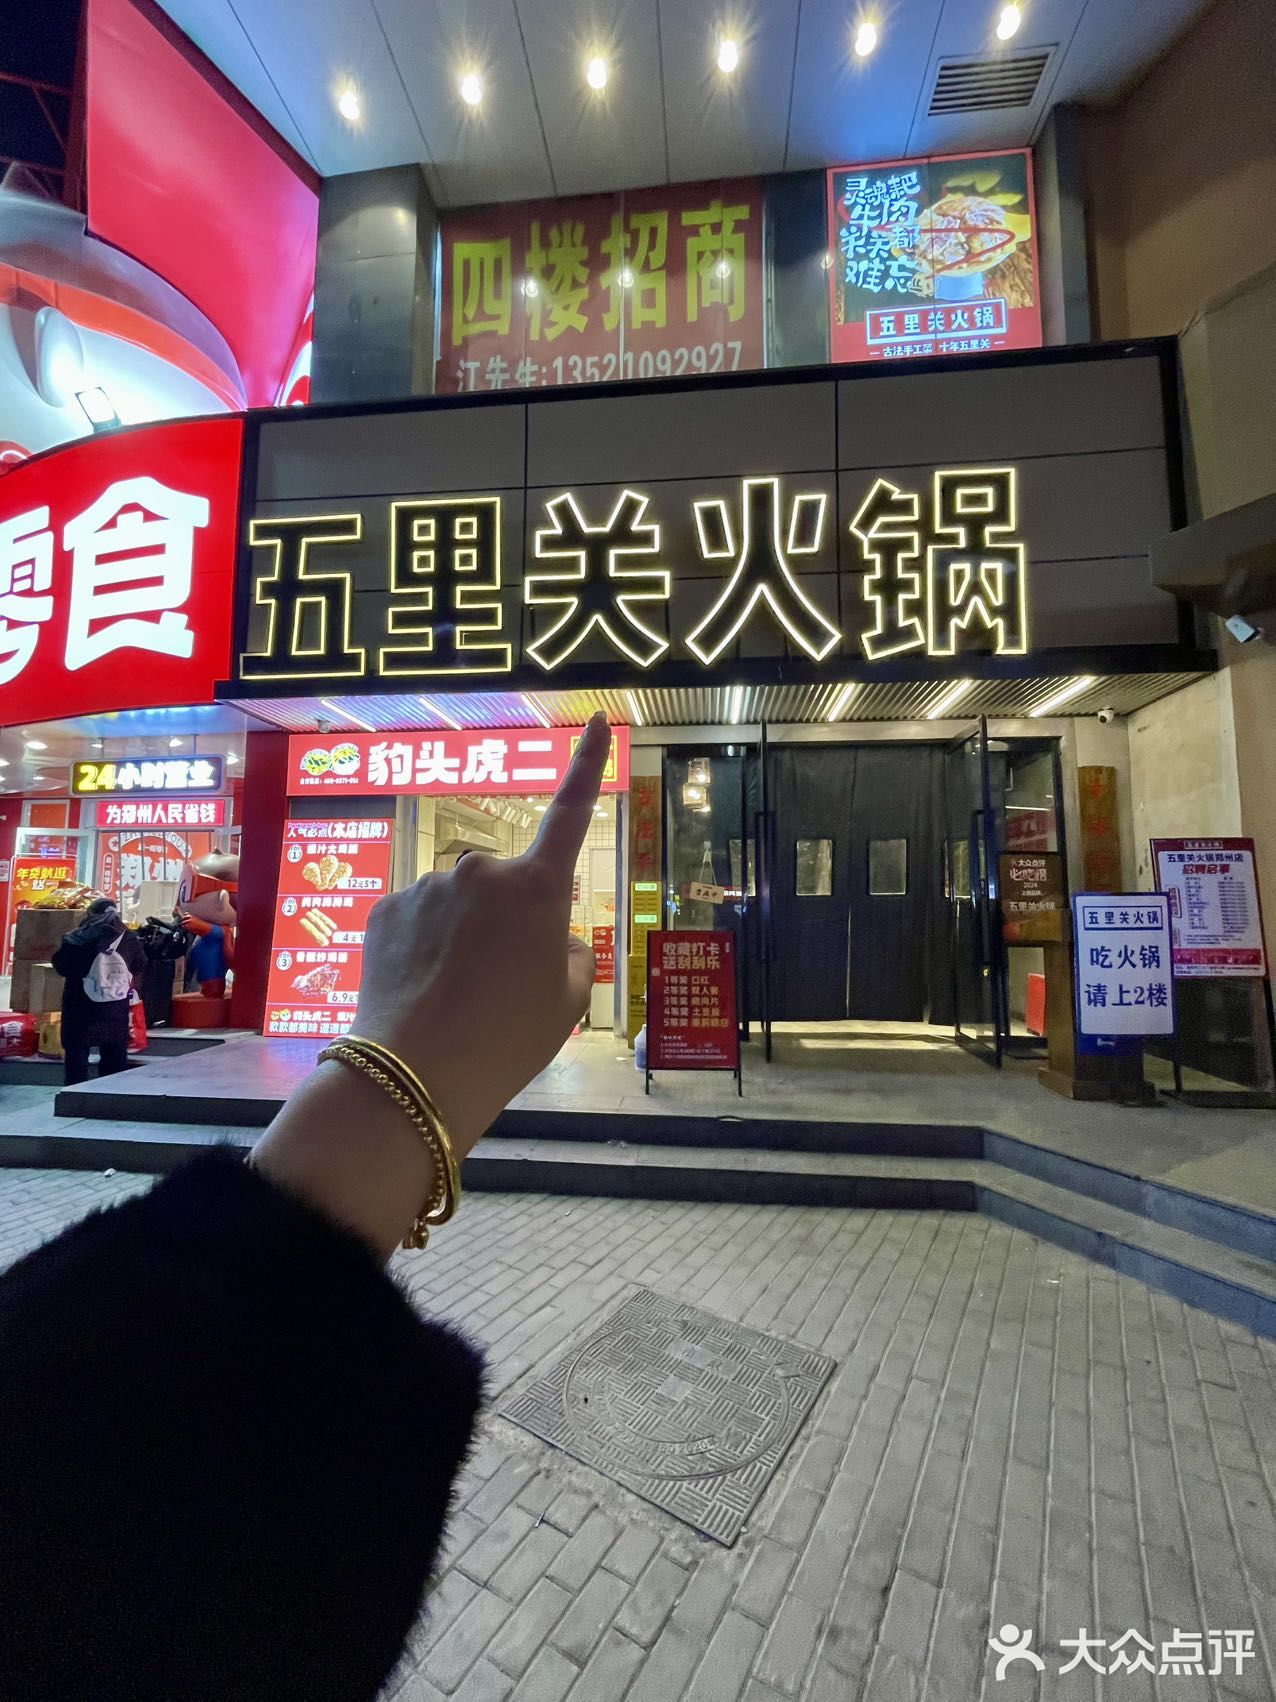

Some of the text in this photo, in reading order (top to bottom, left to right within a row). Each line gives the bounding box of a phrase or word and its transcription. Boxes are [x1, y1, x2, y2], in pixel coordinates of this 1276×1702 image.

[451, 201, 751, 345] 四楼招商
[844, 255, 918, 293] 难忘
[880, 306, 995, 336] 五里关火锅
[939, 338, 991, 353] 十年五里关
[239, 467, 1027, 680] 五里关火锅
[367, 738, 557, 786] 豹头虎二
[78, 760, 216, 791] 24小时营业
[105, 802, 217, 825] 为郑州人民省钱
[1166, 853, 1244, 863] 五里关火锅郑州店
[1088, 910, 1160, 926] 五里关火锅
[662, 942, 720, 956] 收藏打卡
[1090, 944, 1161, 969] 吃火锅
[662, 956, 720, 970] 送刮刮乐
[1084, 983, 1168, 1008] 请上2楼
